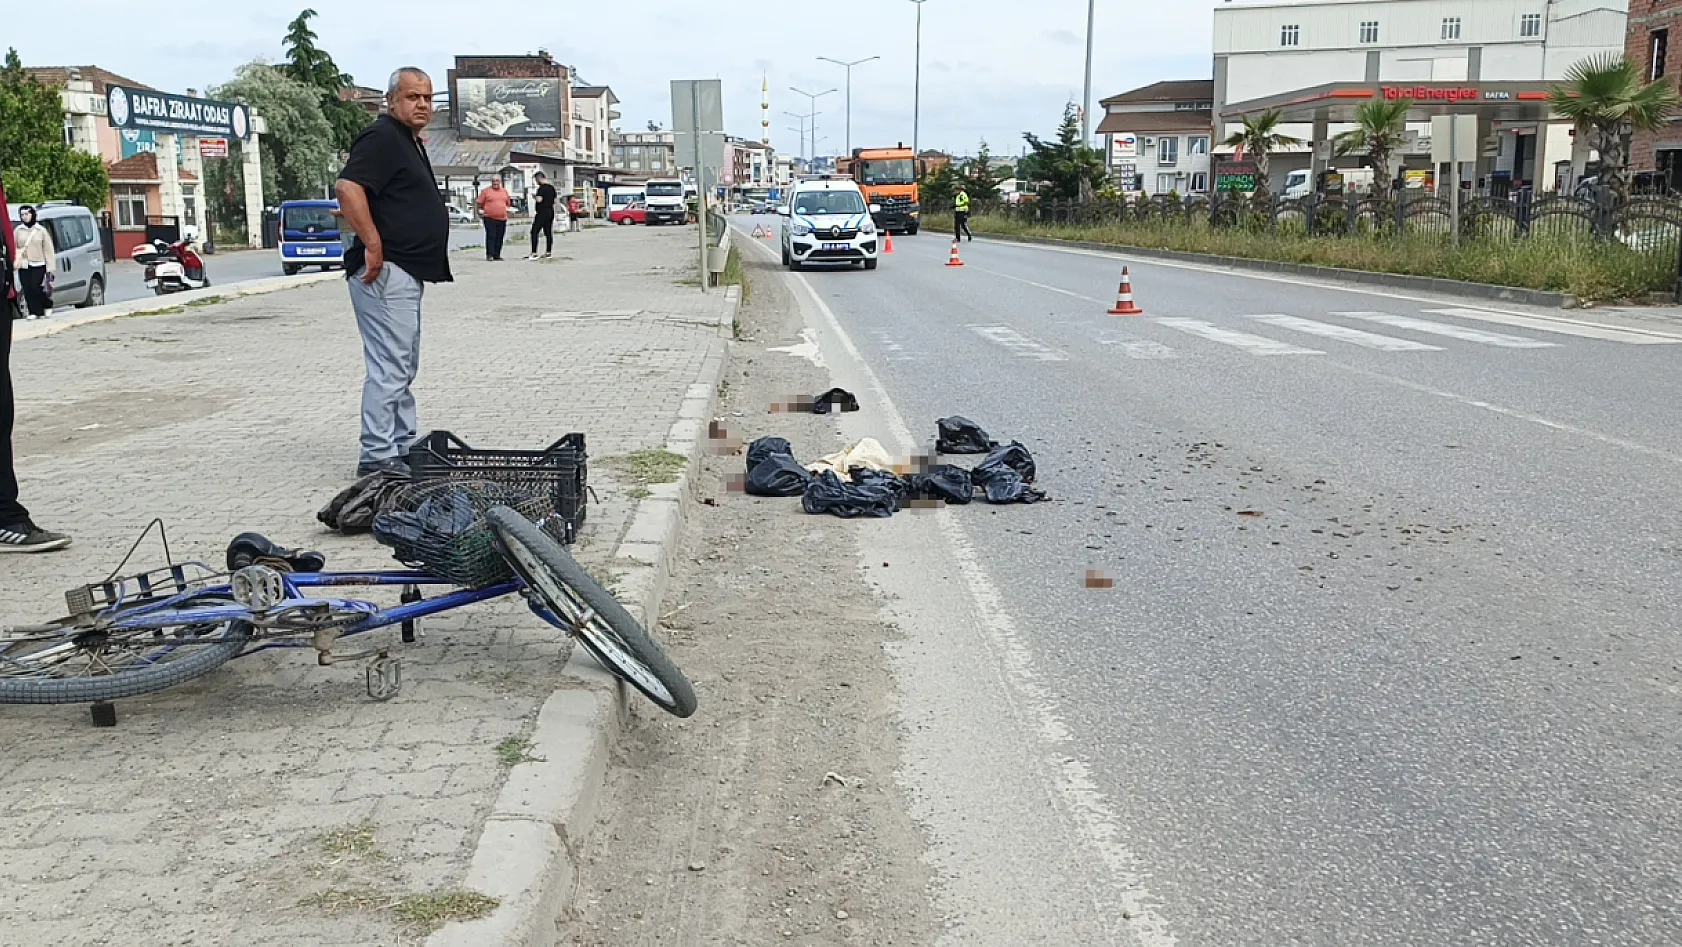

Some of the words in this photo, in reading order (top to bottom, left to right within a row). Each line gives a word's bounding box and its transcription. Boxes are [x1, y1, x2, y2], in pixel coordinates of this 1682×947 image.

[1381, 86, 1478, 102] TotalEnergies
[132, 95, 167, 117] BAFRA
[168, 100, 202, 121] ZİRAAT
[204, 104, 229, 125] ODASI
